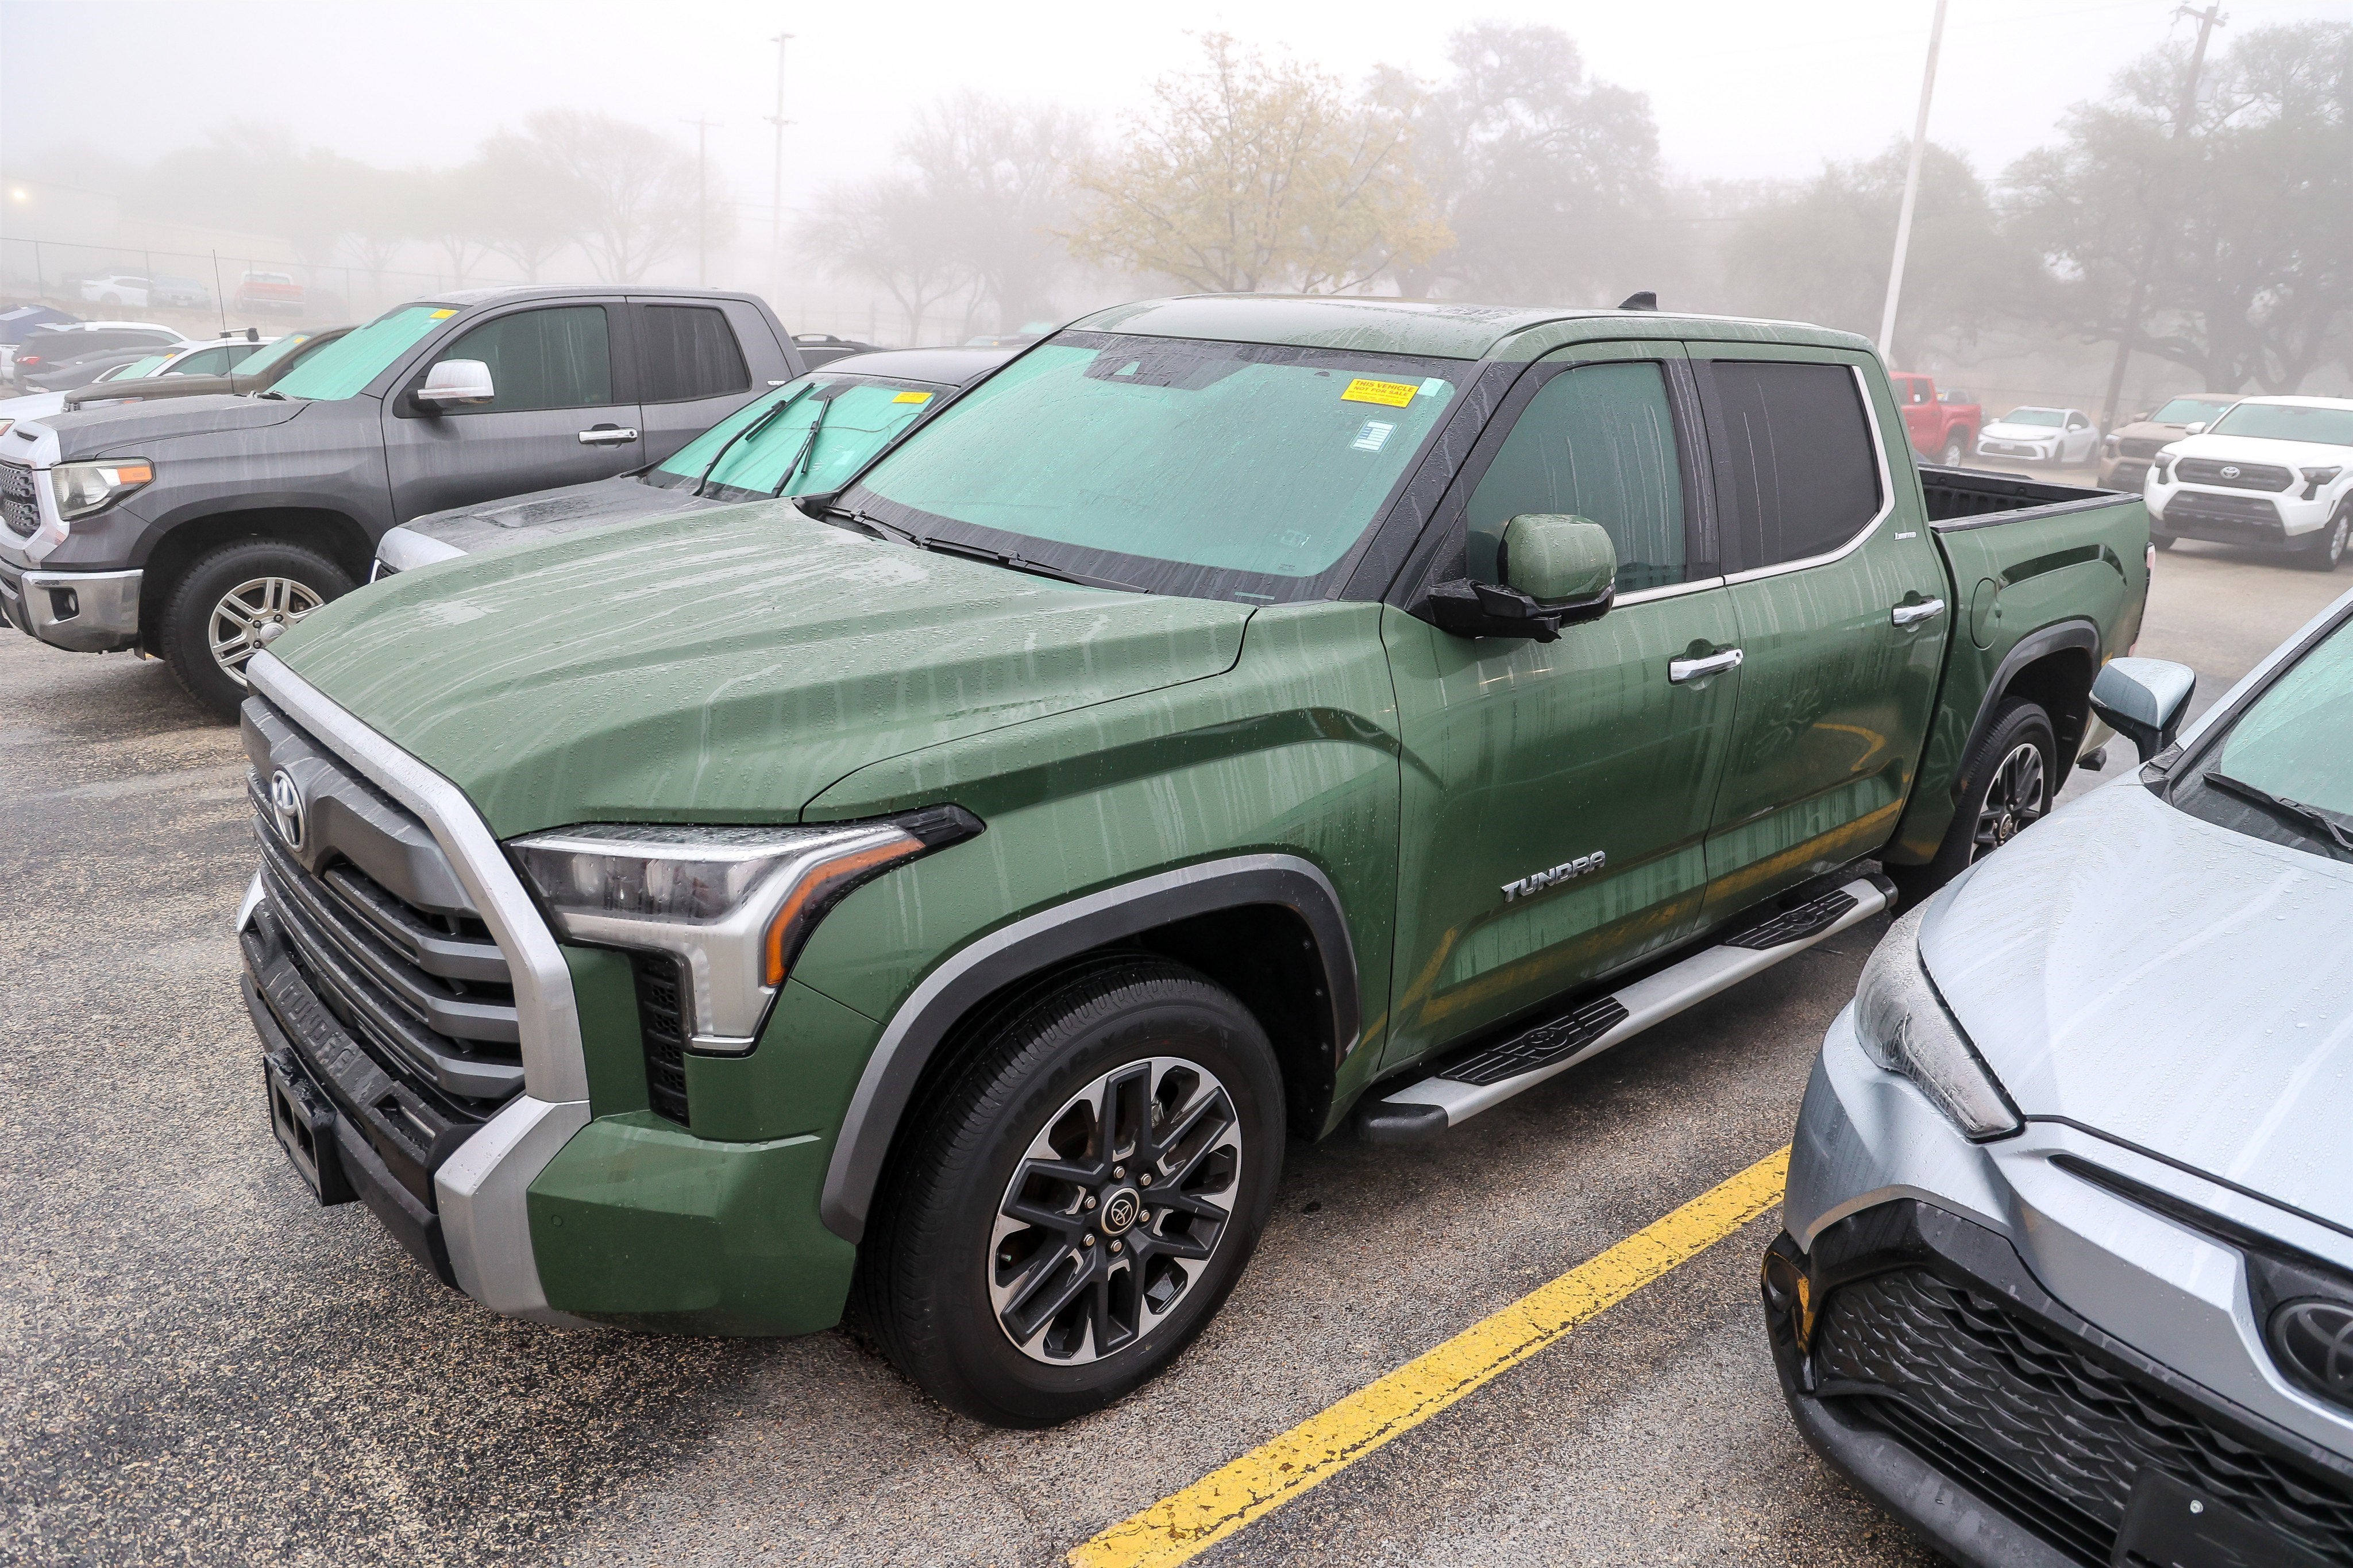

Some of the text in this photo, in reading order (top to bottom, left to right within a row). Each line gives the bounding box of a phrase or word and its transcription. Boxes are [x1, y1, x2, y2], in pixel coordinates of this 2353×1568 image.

[1377, 383, 1414, 392] VEHICLE
[1500, 849, 1606, 902] TUNDRA
[276, 981, 360, 1079] TUNDRA
